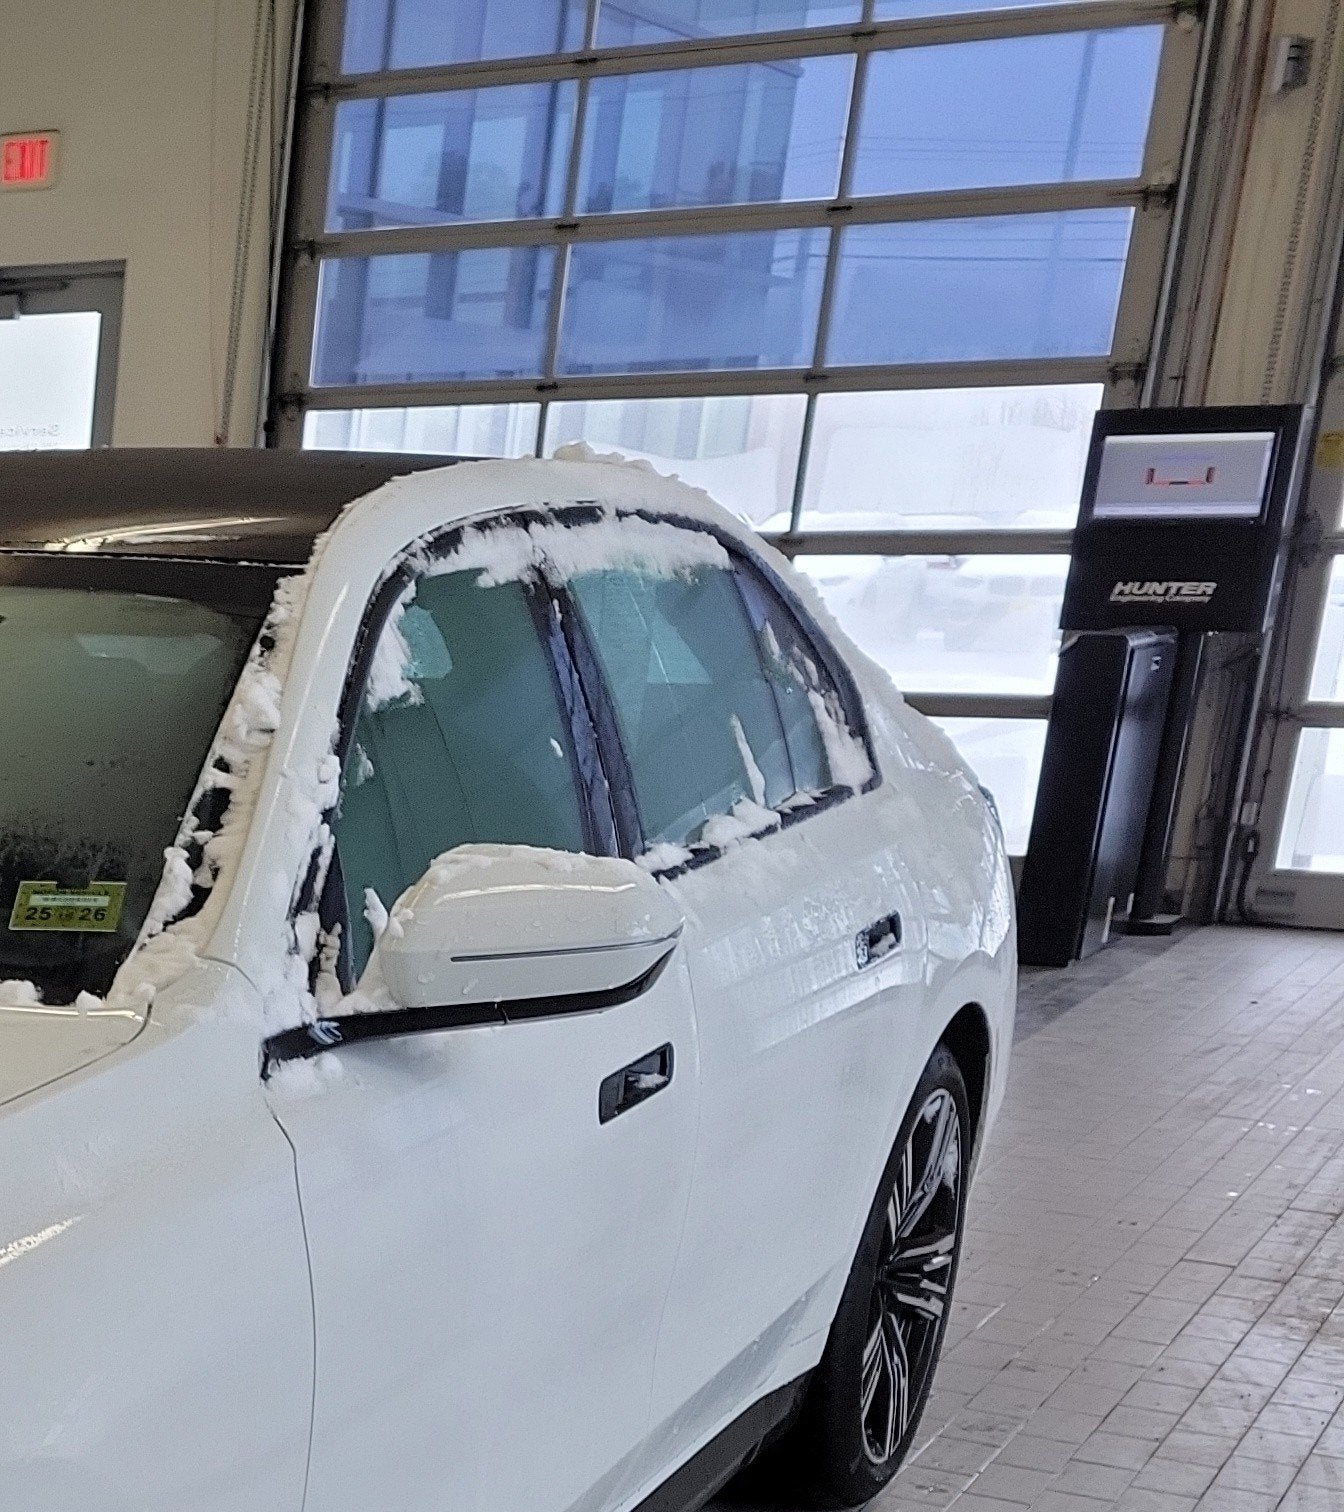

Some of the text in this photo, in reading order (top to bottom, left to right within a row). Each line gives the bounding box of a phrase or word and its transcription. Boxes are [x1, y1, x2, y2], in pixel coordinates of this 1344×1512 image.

[3, 139, 48, 181] EXIT
[1113, 580, 1218, 596] HUNTER
[25, 906, 52, 922] 25
[78, 907, 108, 923] 26
